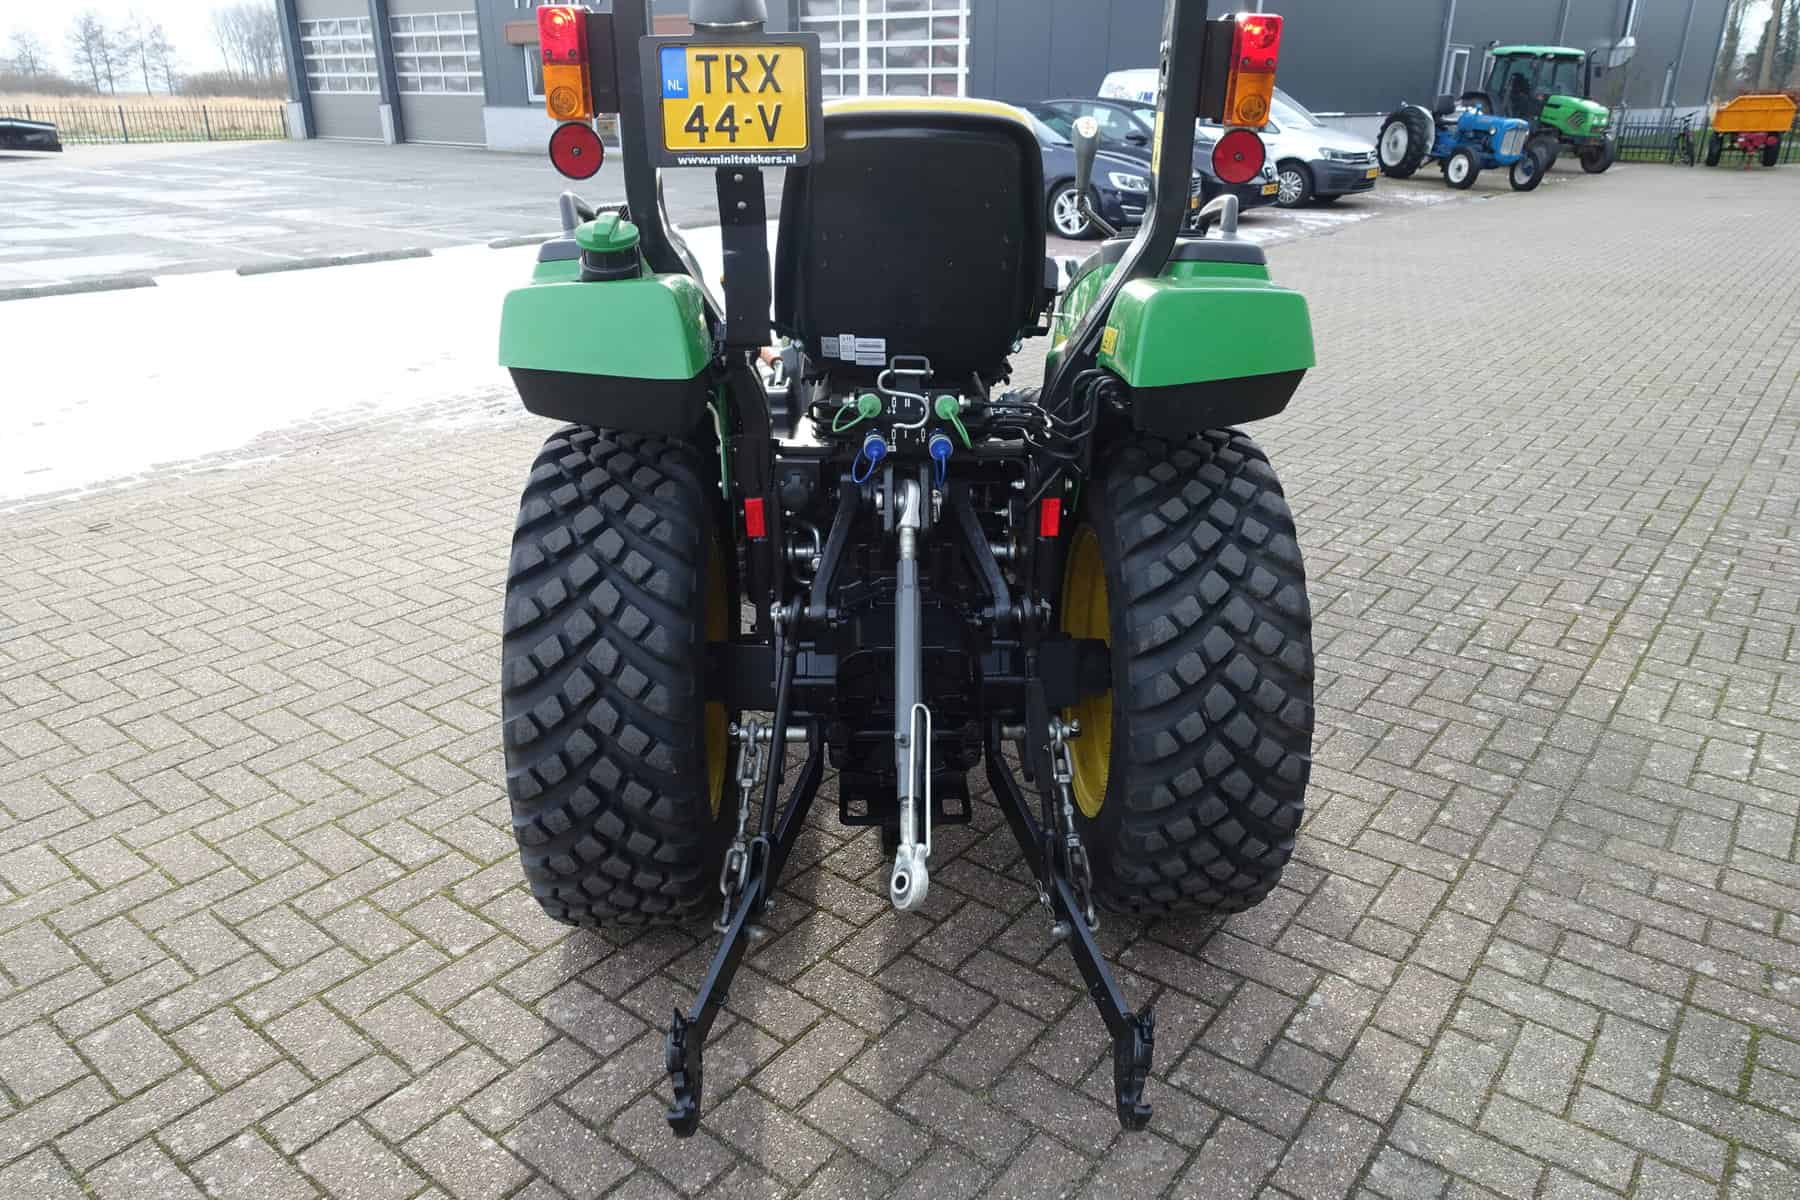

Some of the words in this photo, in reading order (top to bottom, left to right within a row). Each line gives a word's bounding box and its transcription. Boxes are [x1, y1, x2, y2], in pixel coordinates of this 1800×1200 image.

[667, 79, 683, 91] NL
[695, 53, 782, 94] TRX
[684, 105, 782, 143] 44-V
[677, 154, 797, 166] www.minitrekkers.nl
